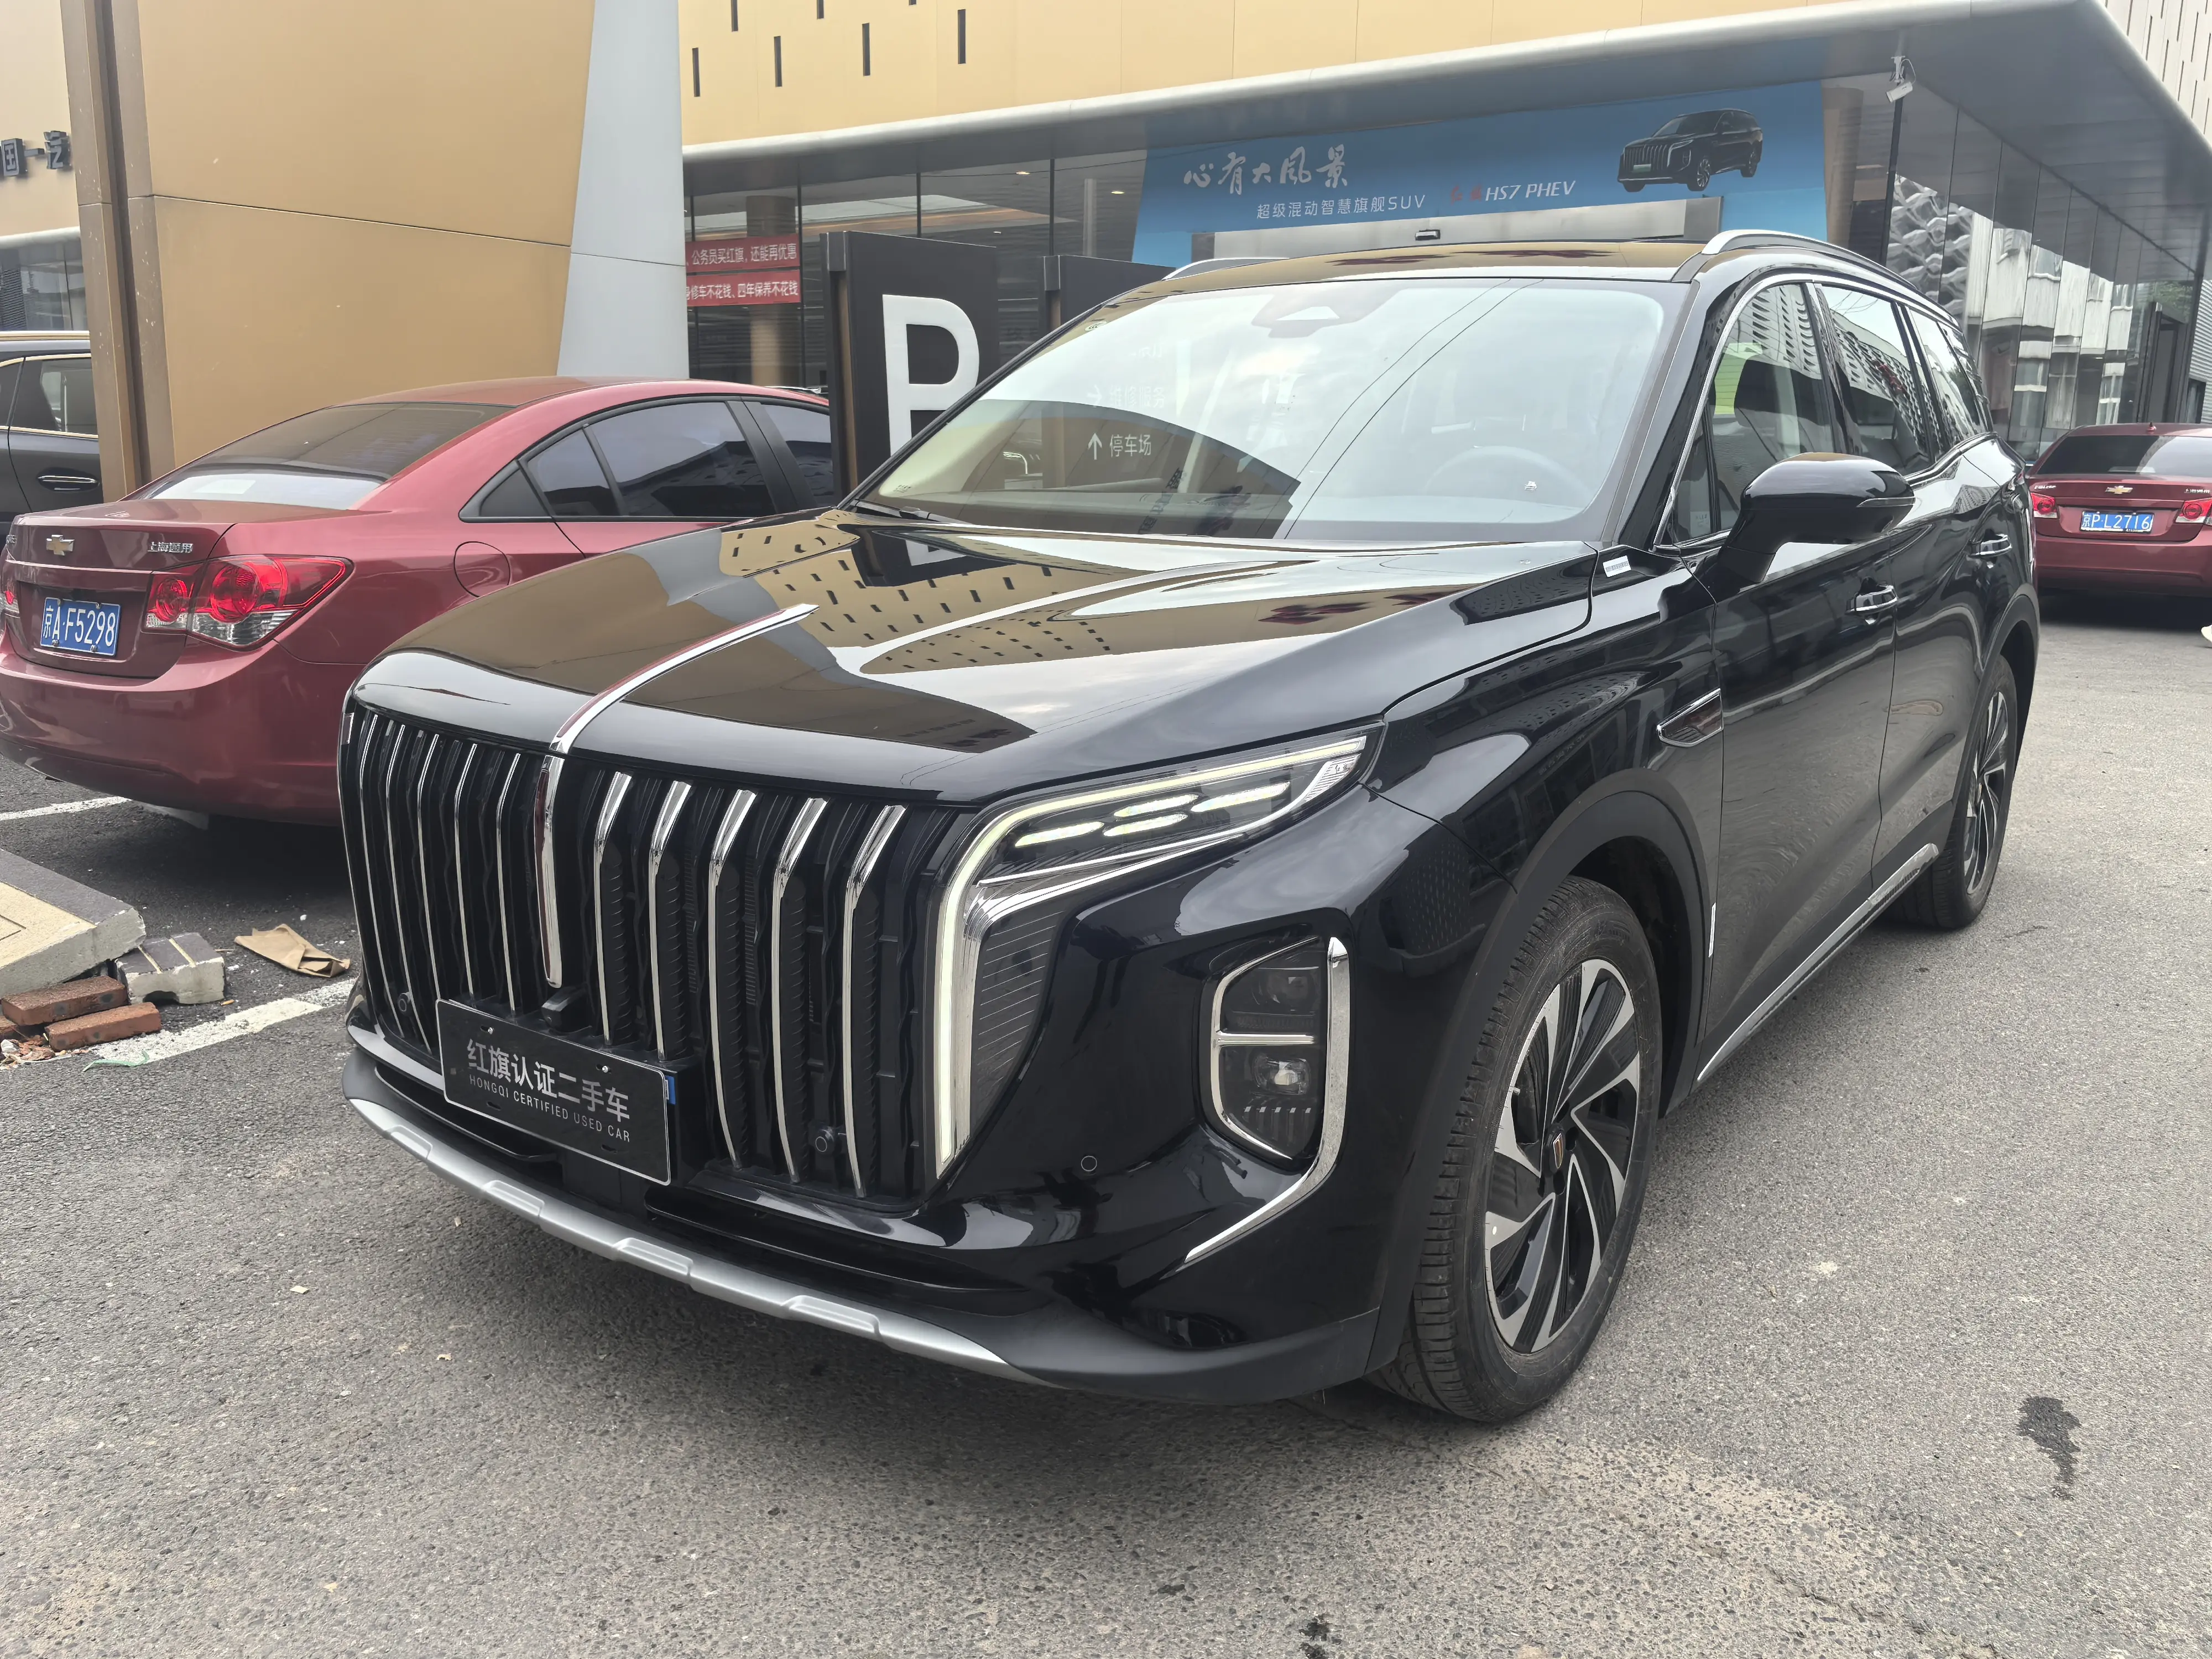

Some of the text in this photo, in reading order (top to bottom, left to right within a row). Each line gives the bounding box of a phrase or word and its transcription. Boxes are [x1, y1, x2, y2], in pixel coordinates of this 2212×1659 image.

[1485, 185, 1521, 201] HS7
[1525, 180, 1577, 199] PHEV
[1256, 194, 1426, 220] 超级混动智慧旗舰SUV
[883, 294, 980, 456] P
[1109, 384, 1166, 408] 维修服务
[1109, 434, 1152, 457] 停车场
[147, 541, 194, 554] 上海通用
[467, 1039, 630, 1122] 红旗认证二手车
[469, 1074, 630, 1142] HONGQI CERTIFIED USED CAR
